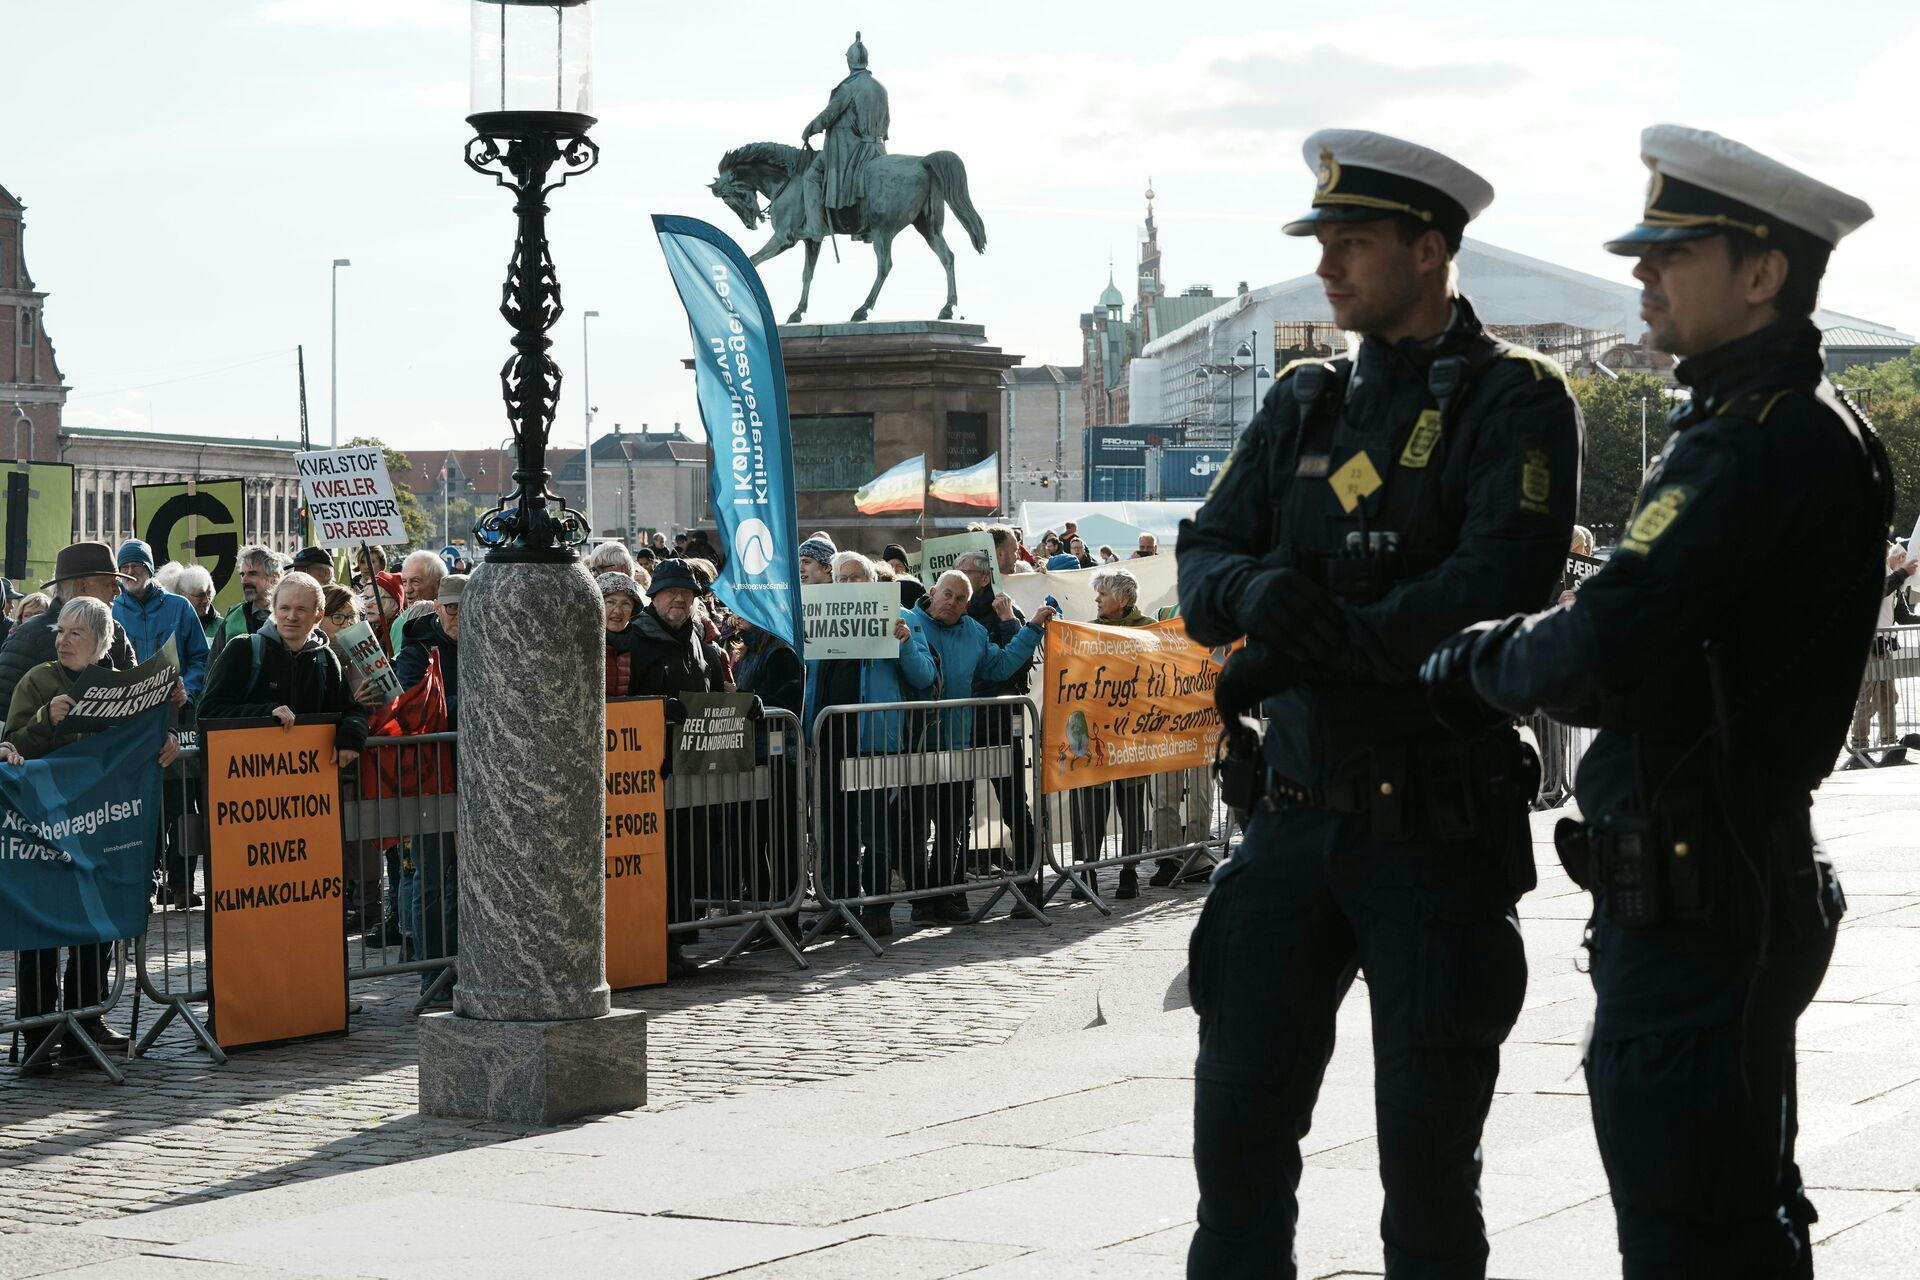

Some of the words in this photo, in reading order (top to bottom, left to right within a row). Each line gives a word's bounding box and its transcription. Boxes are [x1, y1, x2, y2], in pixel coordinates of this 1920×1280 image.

[296, 453, 378, 477] KVÆLSTOF
[312, 478, 378, 499] KVÆLER
[309, 499, 399, 521] PESTICIDER
[322, 519, 392, 540] DRÆBER
[146, 492, 237, 598] G
[826, 601, 879, 616] TREPART
[83, 686, 127, 700] GRØN
[126, 664, 172, 698] TREPART
[1057, 668, 1087, 704] Fra
[1093, 664, 1140, 708] frygt
[1147, 662, 1167, 698] til
[68, 680, 175, 718] KLIMASVIGT
[683, 718, 706, 734] REEL
[1131, 704, 1170, 735] står
[620, 727, 642, 752] TIL
[680, 734, 694, 751] AF
[695, 732, 745, 751] LANDBRUGET
[1107, 734, 1198, 767] Bedsteforældrenes
[227, 749, 320, 780] ANIMALSK
[217, 793, 331, 826] PRODUKTION
[1, 835, 5, 860] i
[247, 837, 308, 867] DRIVER
[615, 853, 642, 878] DYR
[214, 876, 342, 913] KLIMAKOLLAPS
